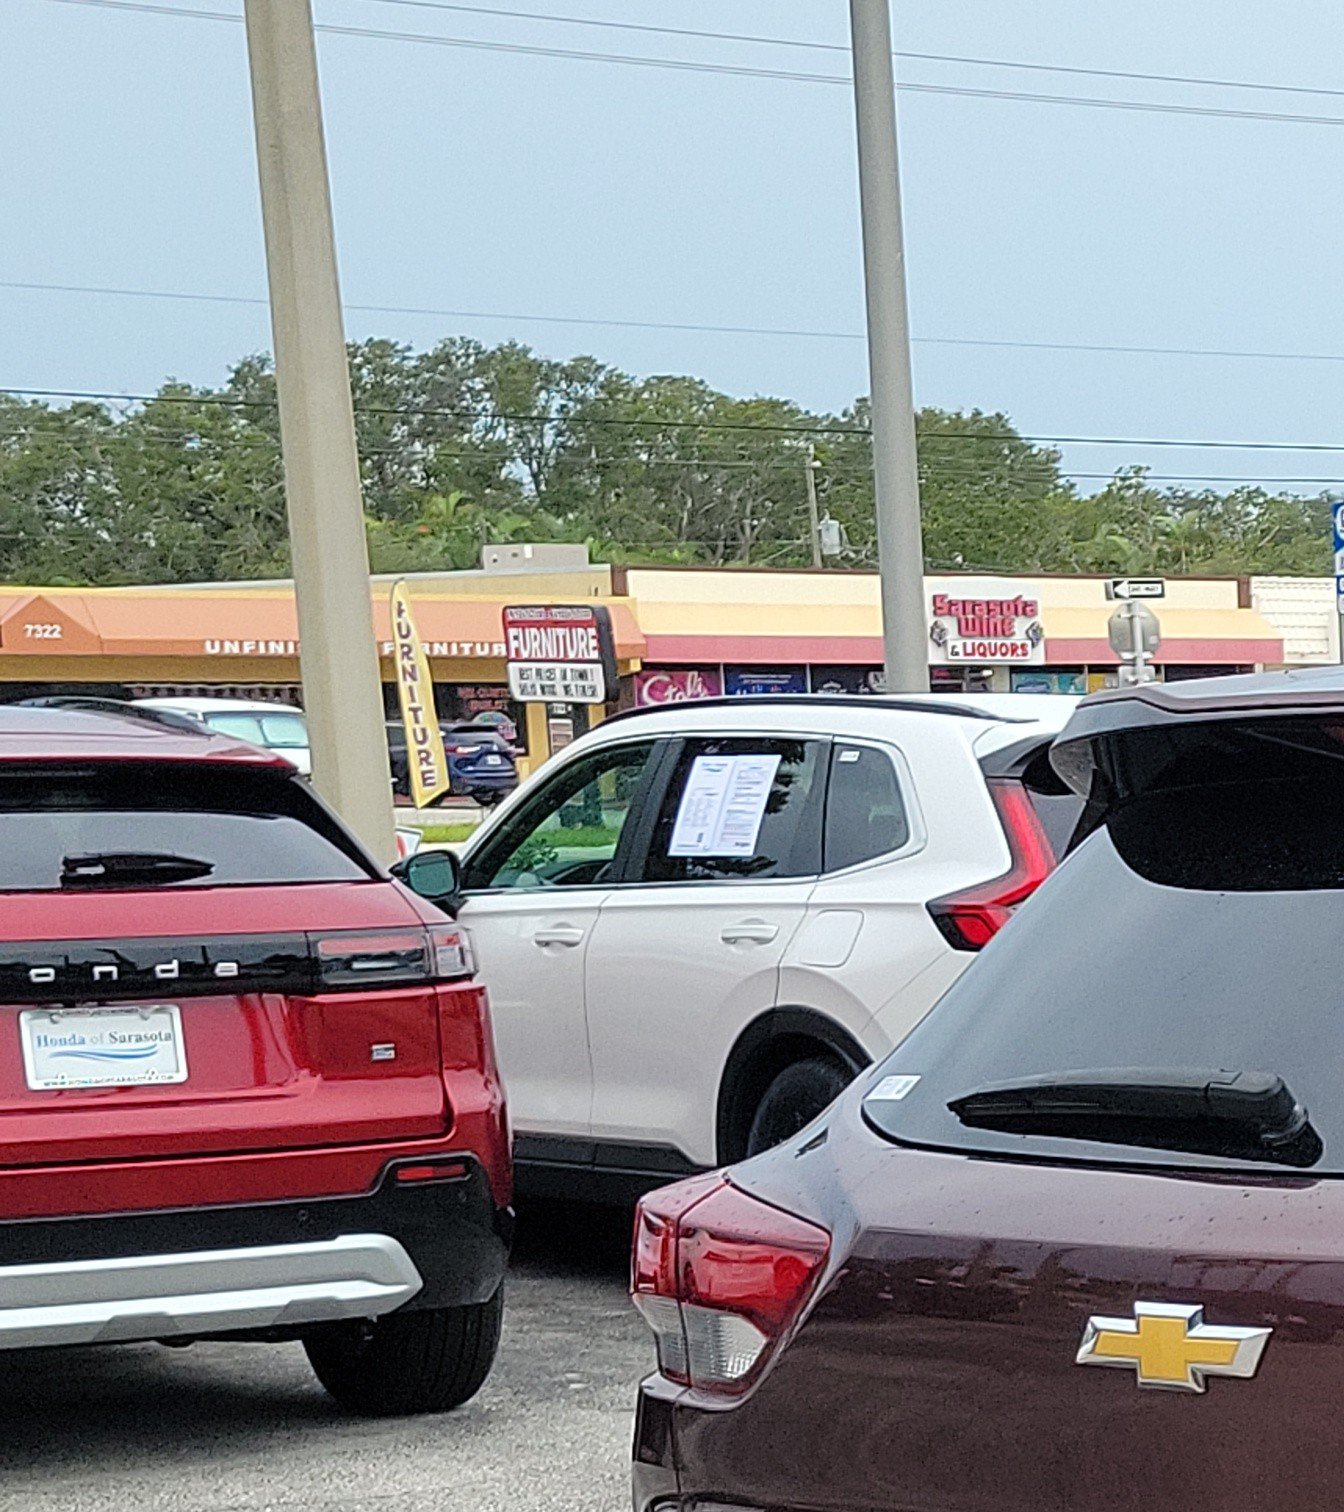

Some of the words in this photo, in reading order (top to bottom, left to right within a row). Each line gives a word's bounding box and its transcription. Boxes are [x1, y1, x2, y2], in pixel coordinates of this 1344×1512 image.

[932, 594, 1038, 617] Sarasota
[24, 624, 62, 638] 7322
[205, 640, 299, 654] UNFINI
[383, 642, 507, 656] FRNITUR
[507, 627, 599, 660] FURNITURE
[950, 645, 960, 657] &
[963, 641, 1029, 657] LIQUORS
[396, 601, 437, 787] FURNITURE
[37, 1034, 86, 1048] Honda
[91, 1033, 104, 1045] of
[109, 1030, 173, 1045] Sarasota
